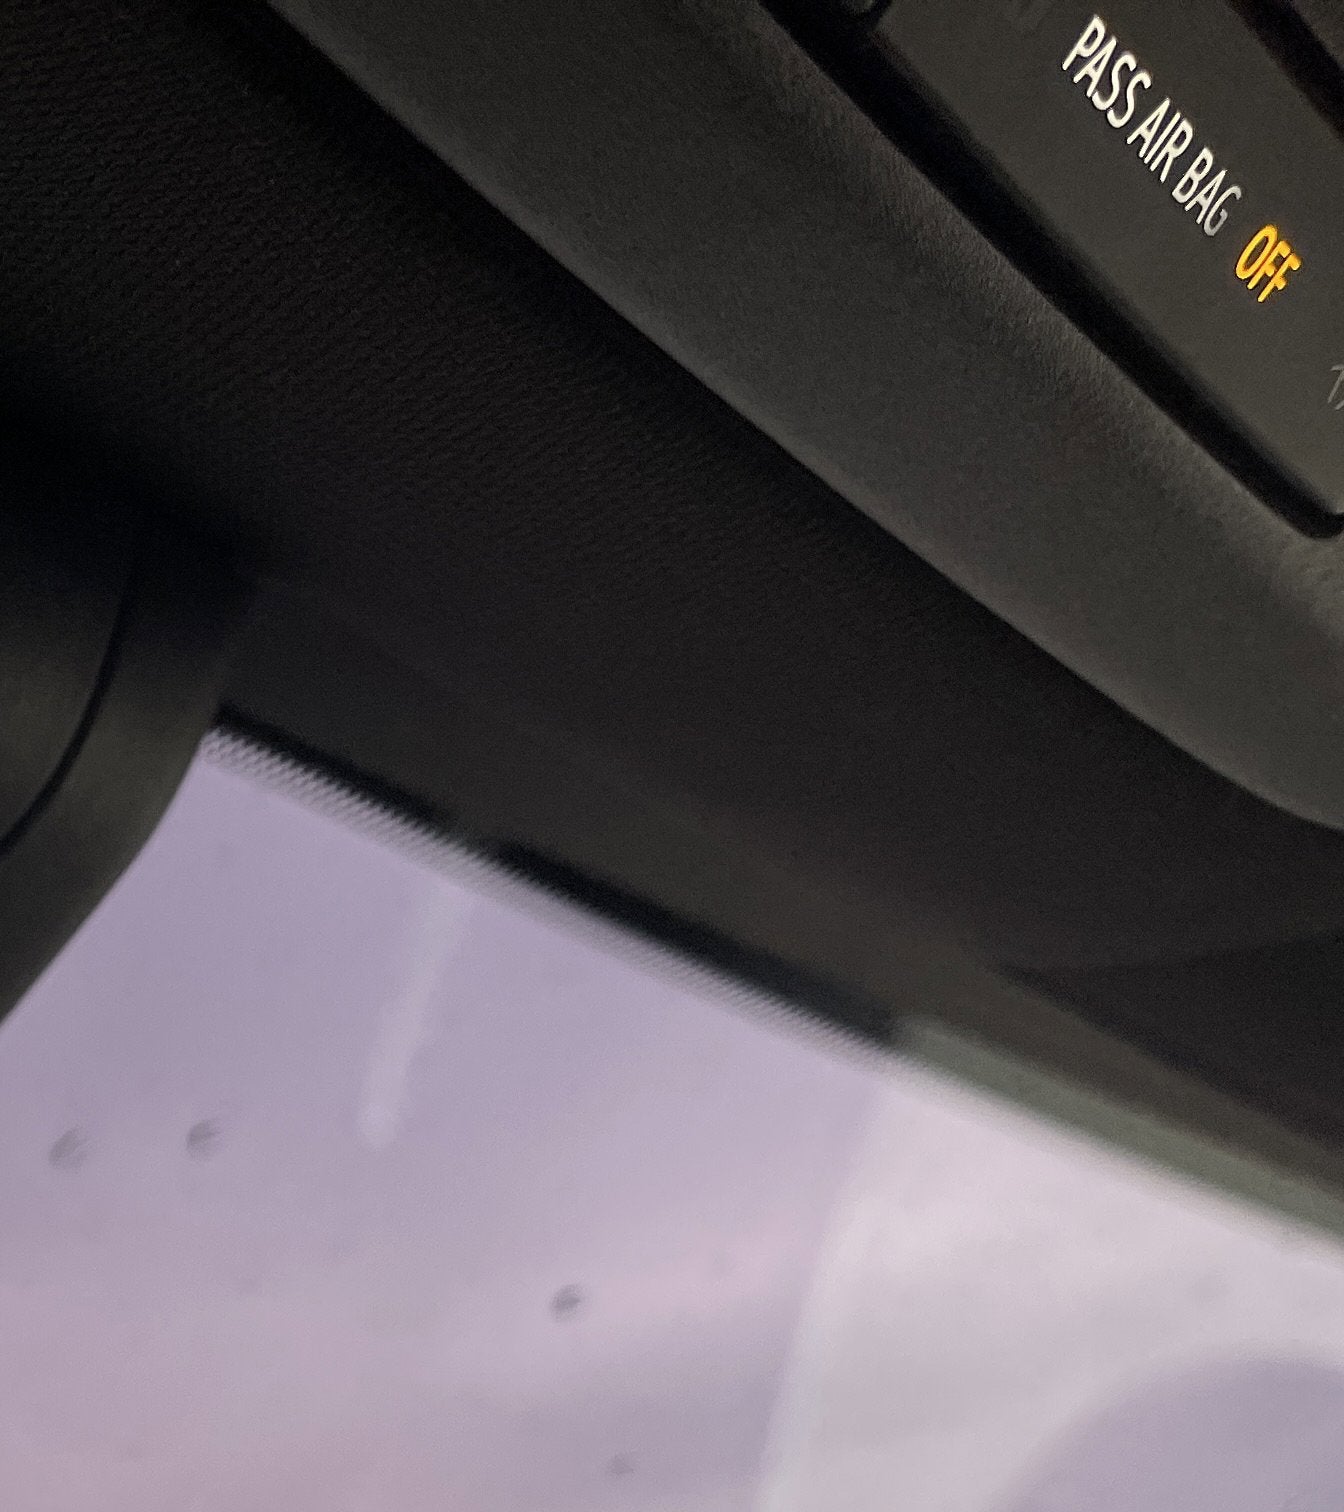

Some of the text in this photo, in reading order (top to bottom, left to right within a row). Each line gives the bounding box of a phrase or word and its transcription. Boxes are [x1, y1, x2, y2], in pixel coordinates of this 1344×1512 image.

[1061, 14, 1302, 303] PASS AIR BAG OFF
